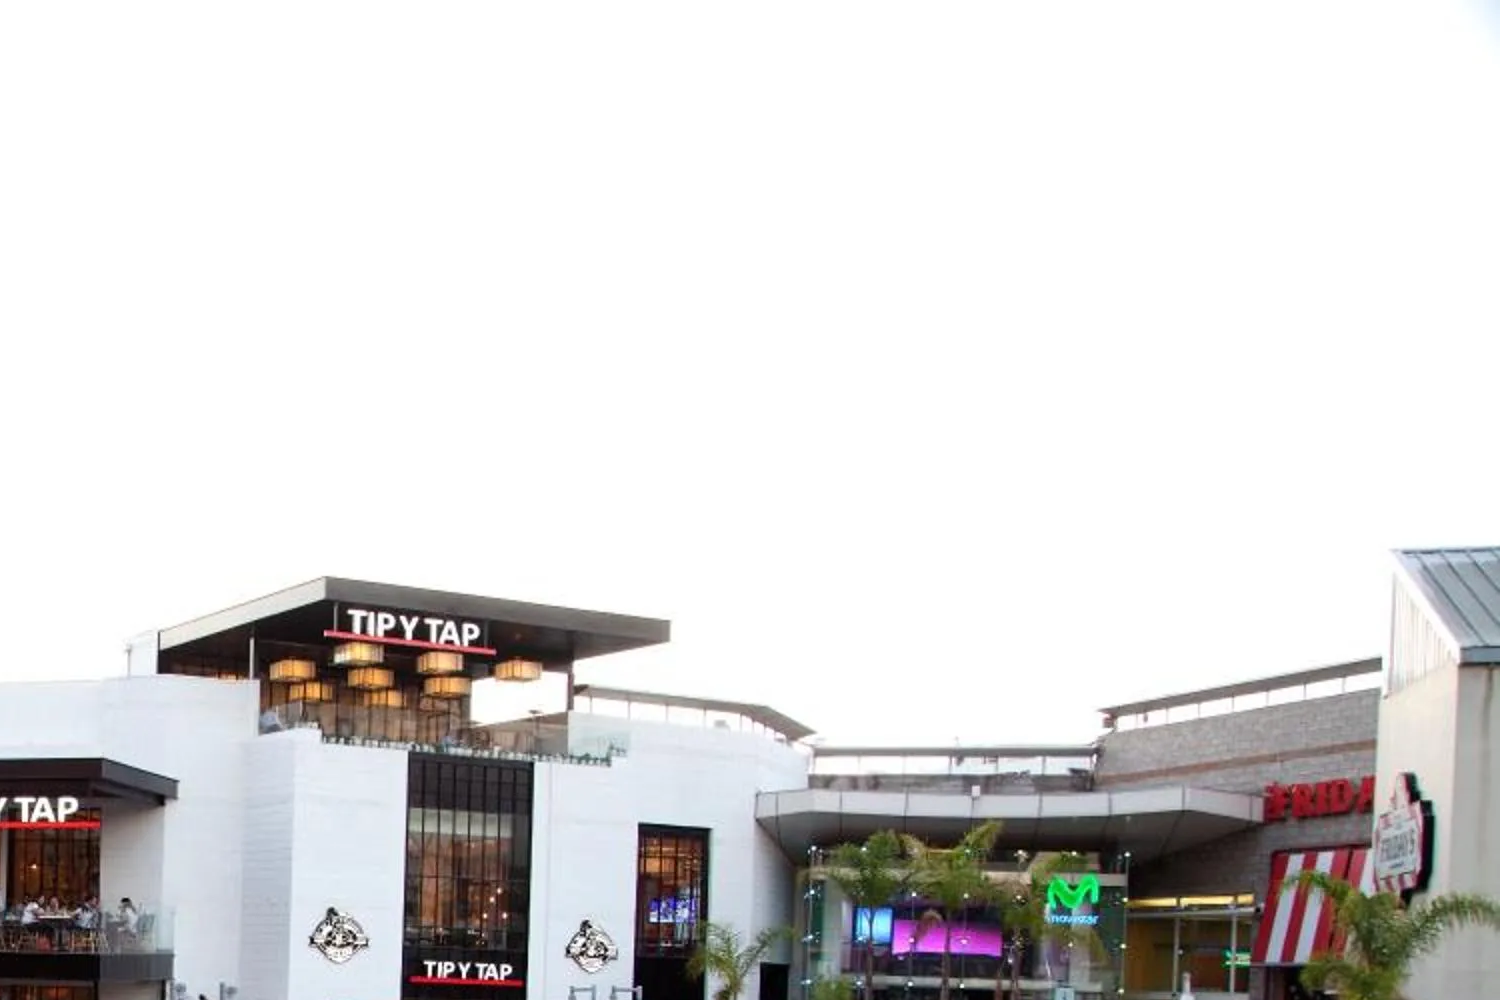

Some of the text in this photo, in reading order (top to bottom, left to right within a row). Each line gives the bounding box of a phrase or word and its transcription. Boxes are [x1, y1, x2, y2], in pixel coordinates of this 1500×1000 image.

[347, 609, 481, 647] TIP Y TAP
[13, 796, 79, 823] TAP
[423, 960, 513, 981] TIP Y TAP
